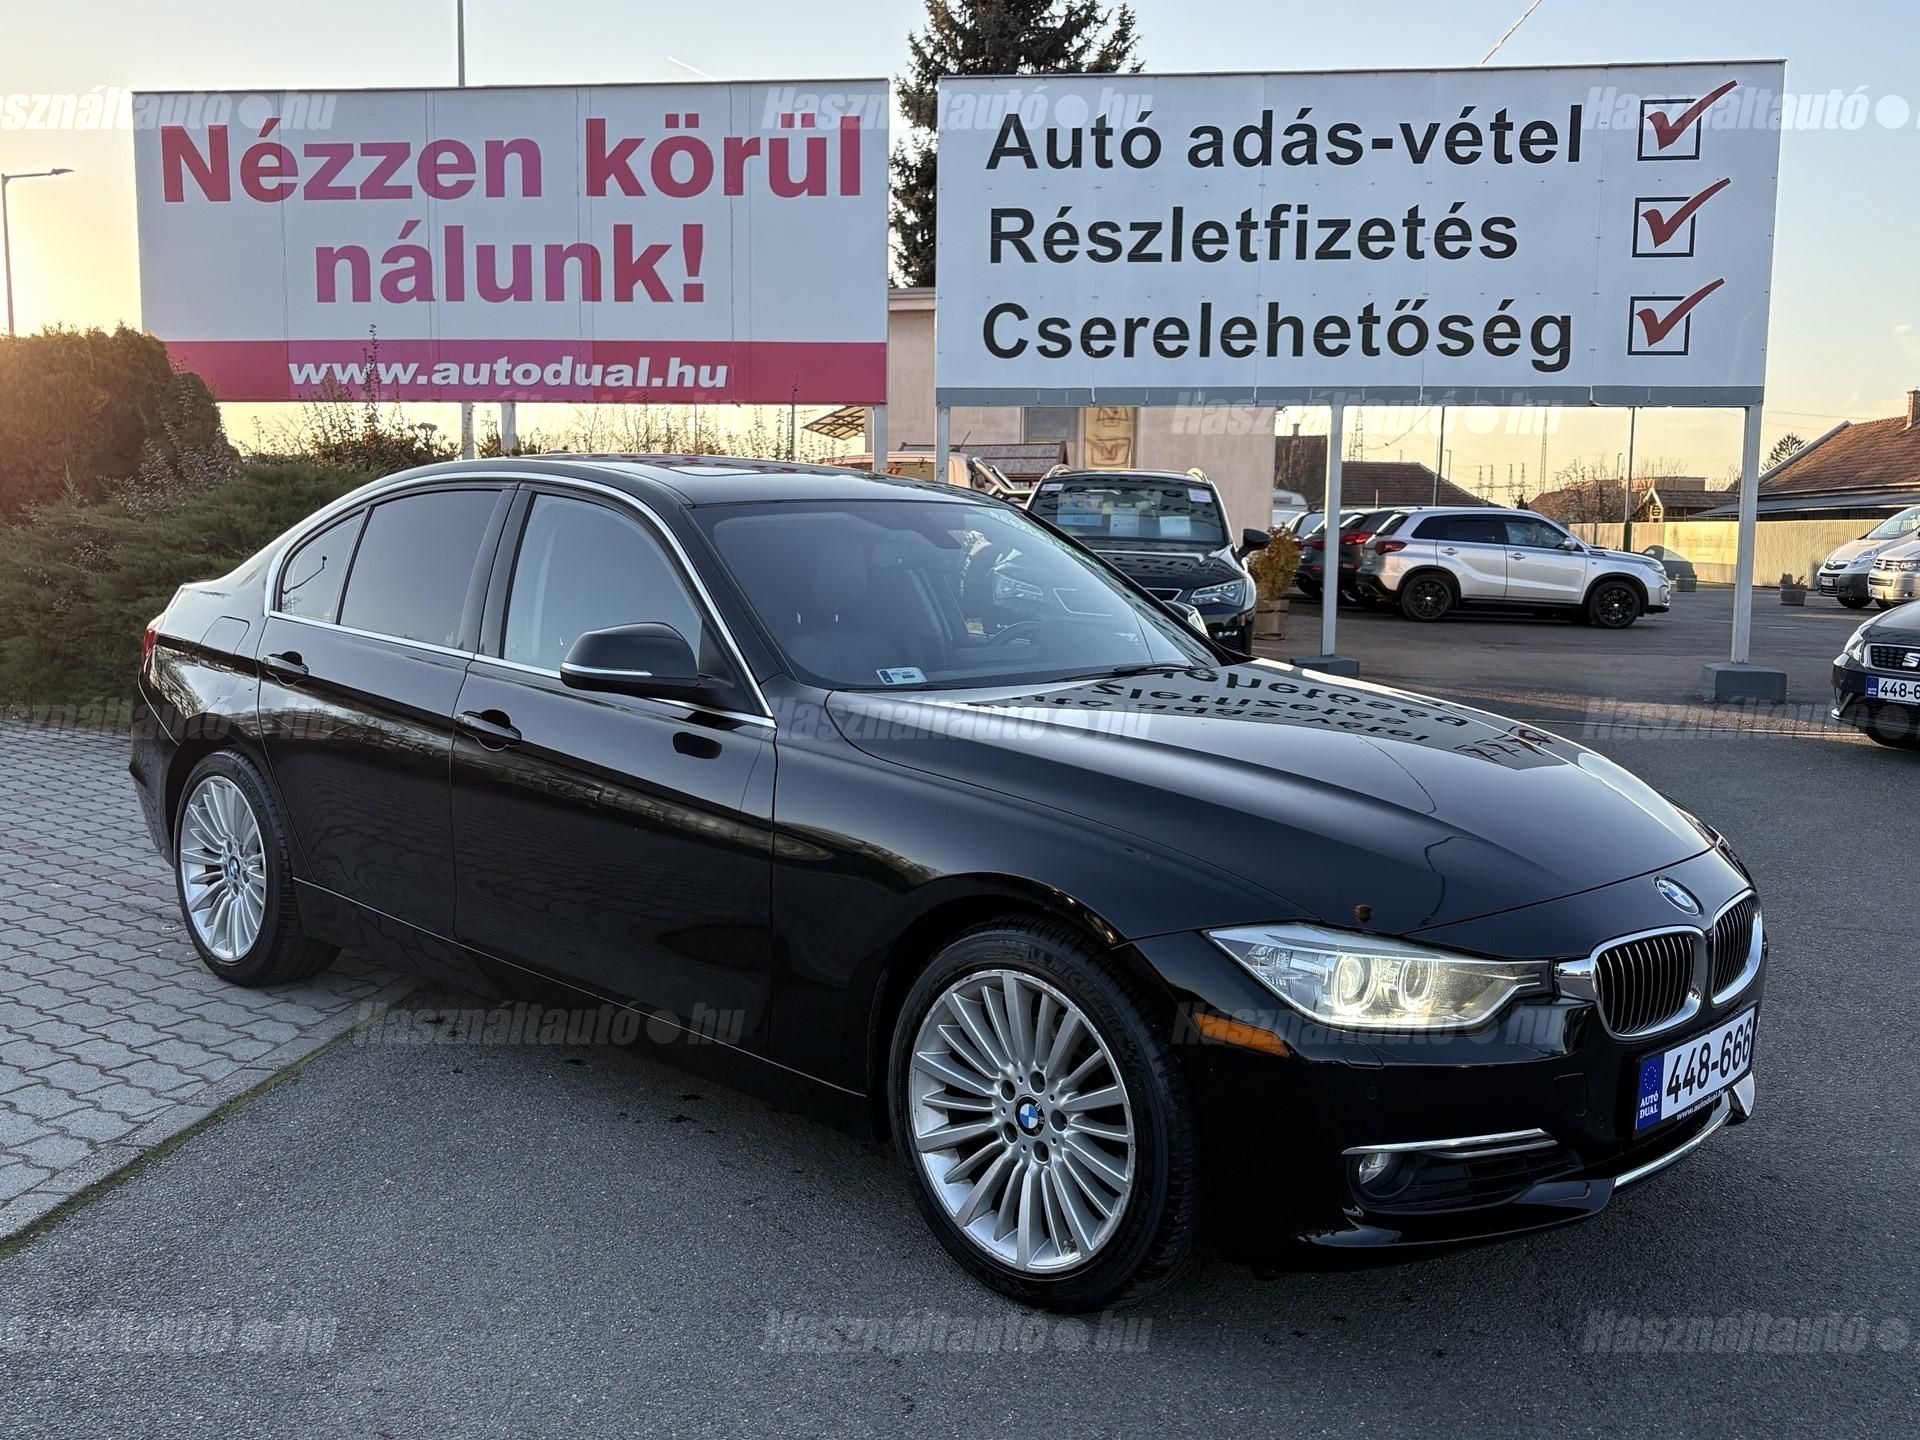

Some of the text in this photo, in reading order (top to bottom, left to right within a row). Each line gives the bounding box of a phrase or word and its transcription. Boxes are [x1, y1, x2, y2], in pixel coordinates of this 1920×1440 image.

[160, 112, 861, 203] Nézzen körül
[985, 104, 1582, 170] Autó adás-vétel
[315, 220, 704, 303] nálunk!
[989, 202, 1518, 264] Részletfizetés
[983, 299, 1572, 372] Cserelehetőség
[289, 356, 728, 390] www.autodual.hu
[1666, 1017, 1752, 1105] 448-666
[1639, 1091, 1659, 1108] AUTÓ
[1639, 1106, 1659, 1120] DUAL
